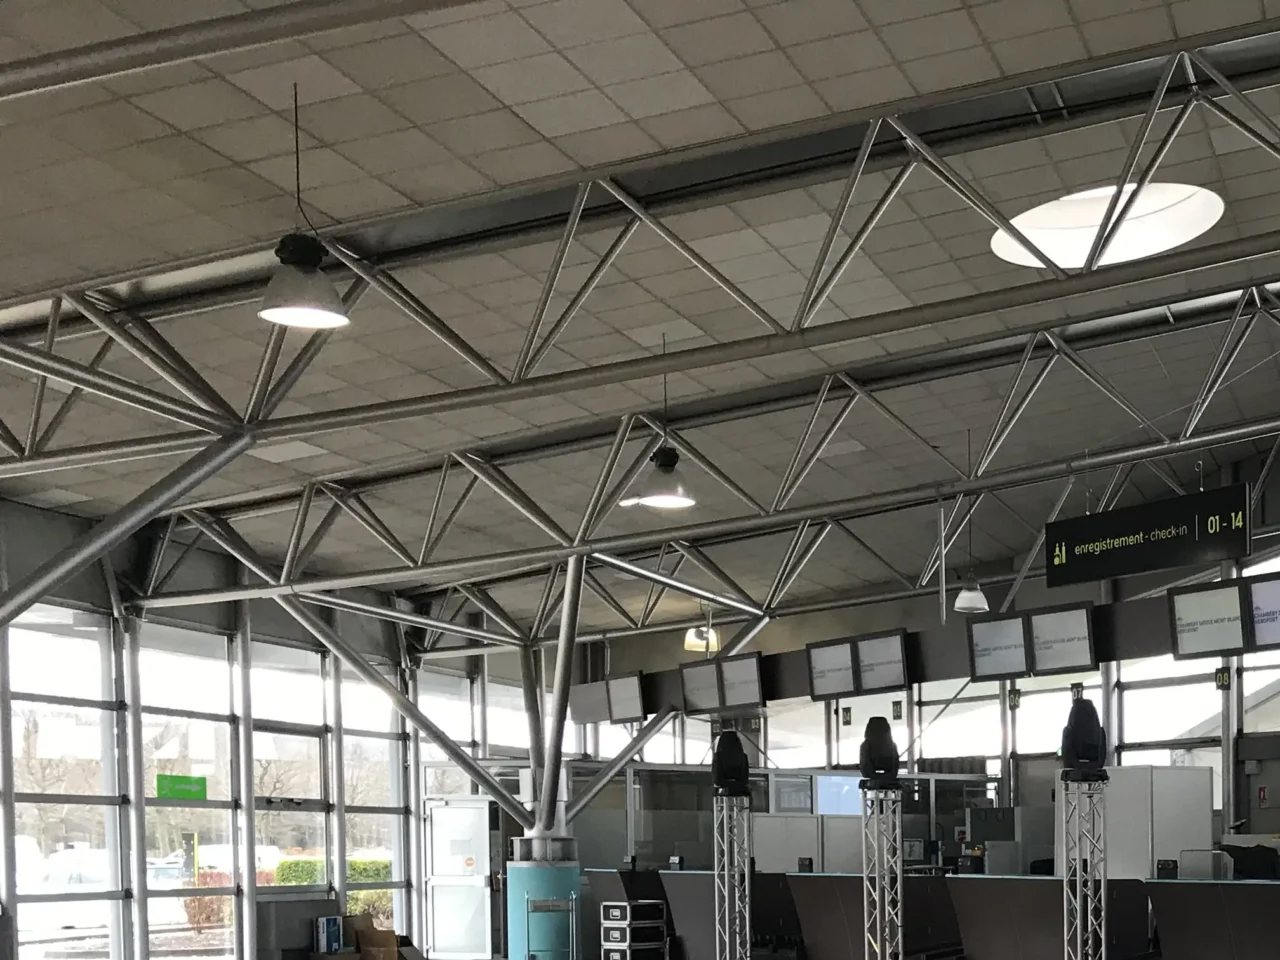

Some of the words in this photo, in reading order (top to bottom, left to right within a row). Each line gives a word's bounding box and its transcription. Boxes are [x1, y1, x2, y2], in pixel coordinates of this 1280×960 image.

[1074, 532, 1144, 556] enregistrement
[1150, 524, 1188, 542] check-in
[1207, 515, 1220, 534] 01
[1231, 511, 1244, 530] 14
[1216, 672, 1229, 686] 08
[1072, 688, 1082, 700] 07
